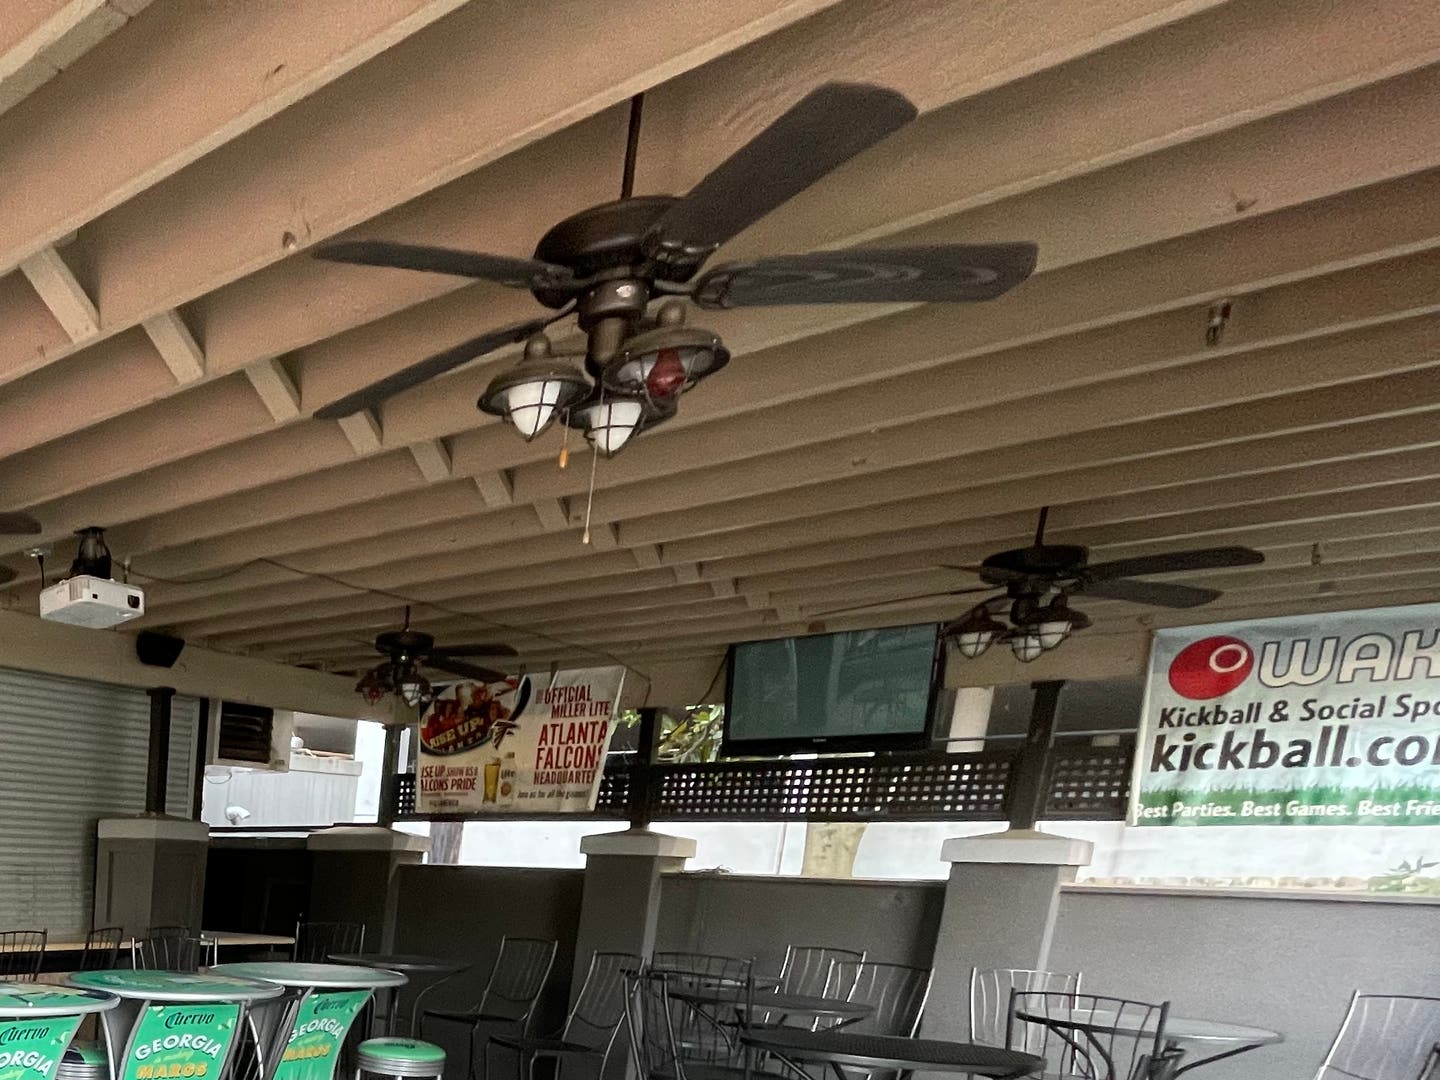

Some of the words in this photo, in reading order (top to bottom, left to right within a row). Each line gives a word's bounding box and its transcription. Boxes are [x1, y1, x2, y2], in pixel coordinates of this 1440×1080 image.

[545, 684, 592, 704] OFFICIAL
[551, 702, 586, 719] MILLER
[589, 701, 610, 716] LITE
[1158, 702, 1262, 728] Kickball
[1268, 700, 1289, 722] &
[1299, 696, 1387, 721] Social
[538, 721, 608, 746] ATLANTA
[1150, 725, 1440, 772] kickball.co
[450, 778, 477, 791] PRIDE
[1241, 800, 1281, 816] Best
[1286, 800, 1353, 816] Games.
[1358, 799, 1400, 816] Best
[165, 1012, 214, 1029] Cuervo
[135, 1034, 222, 1060] GEORGIA
